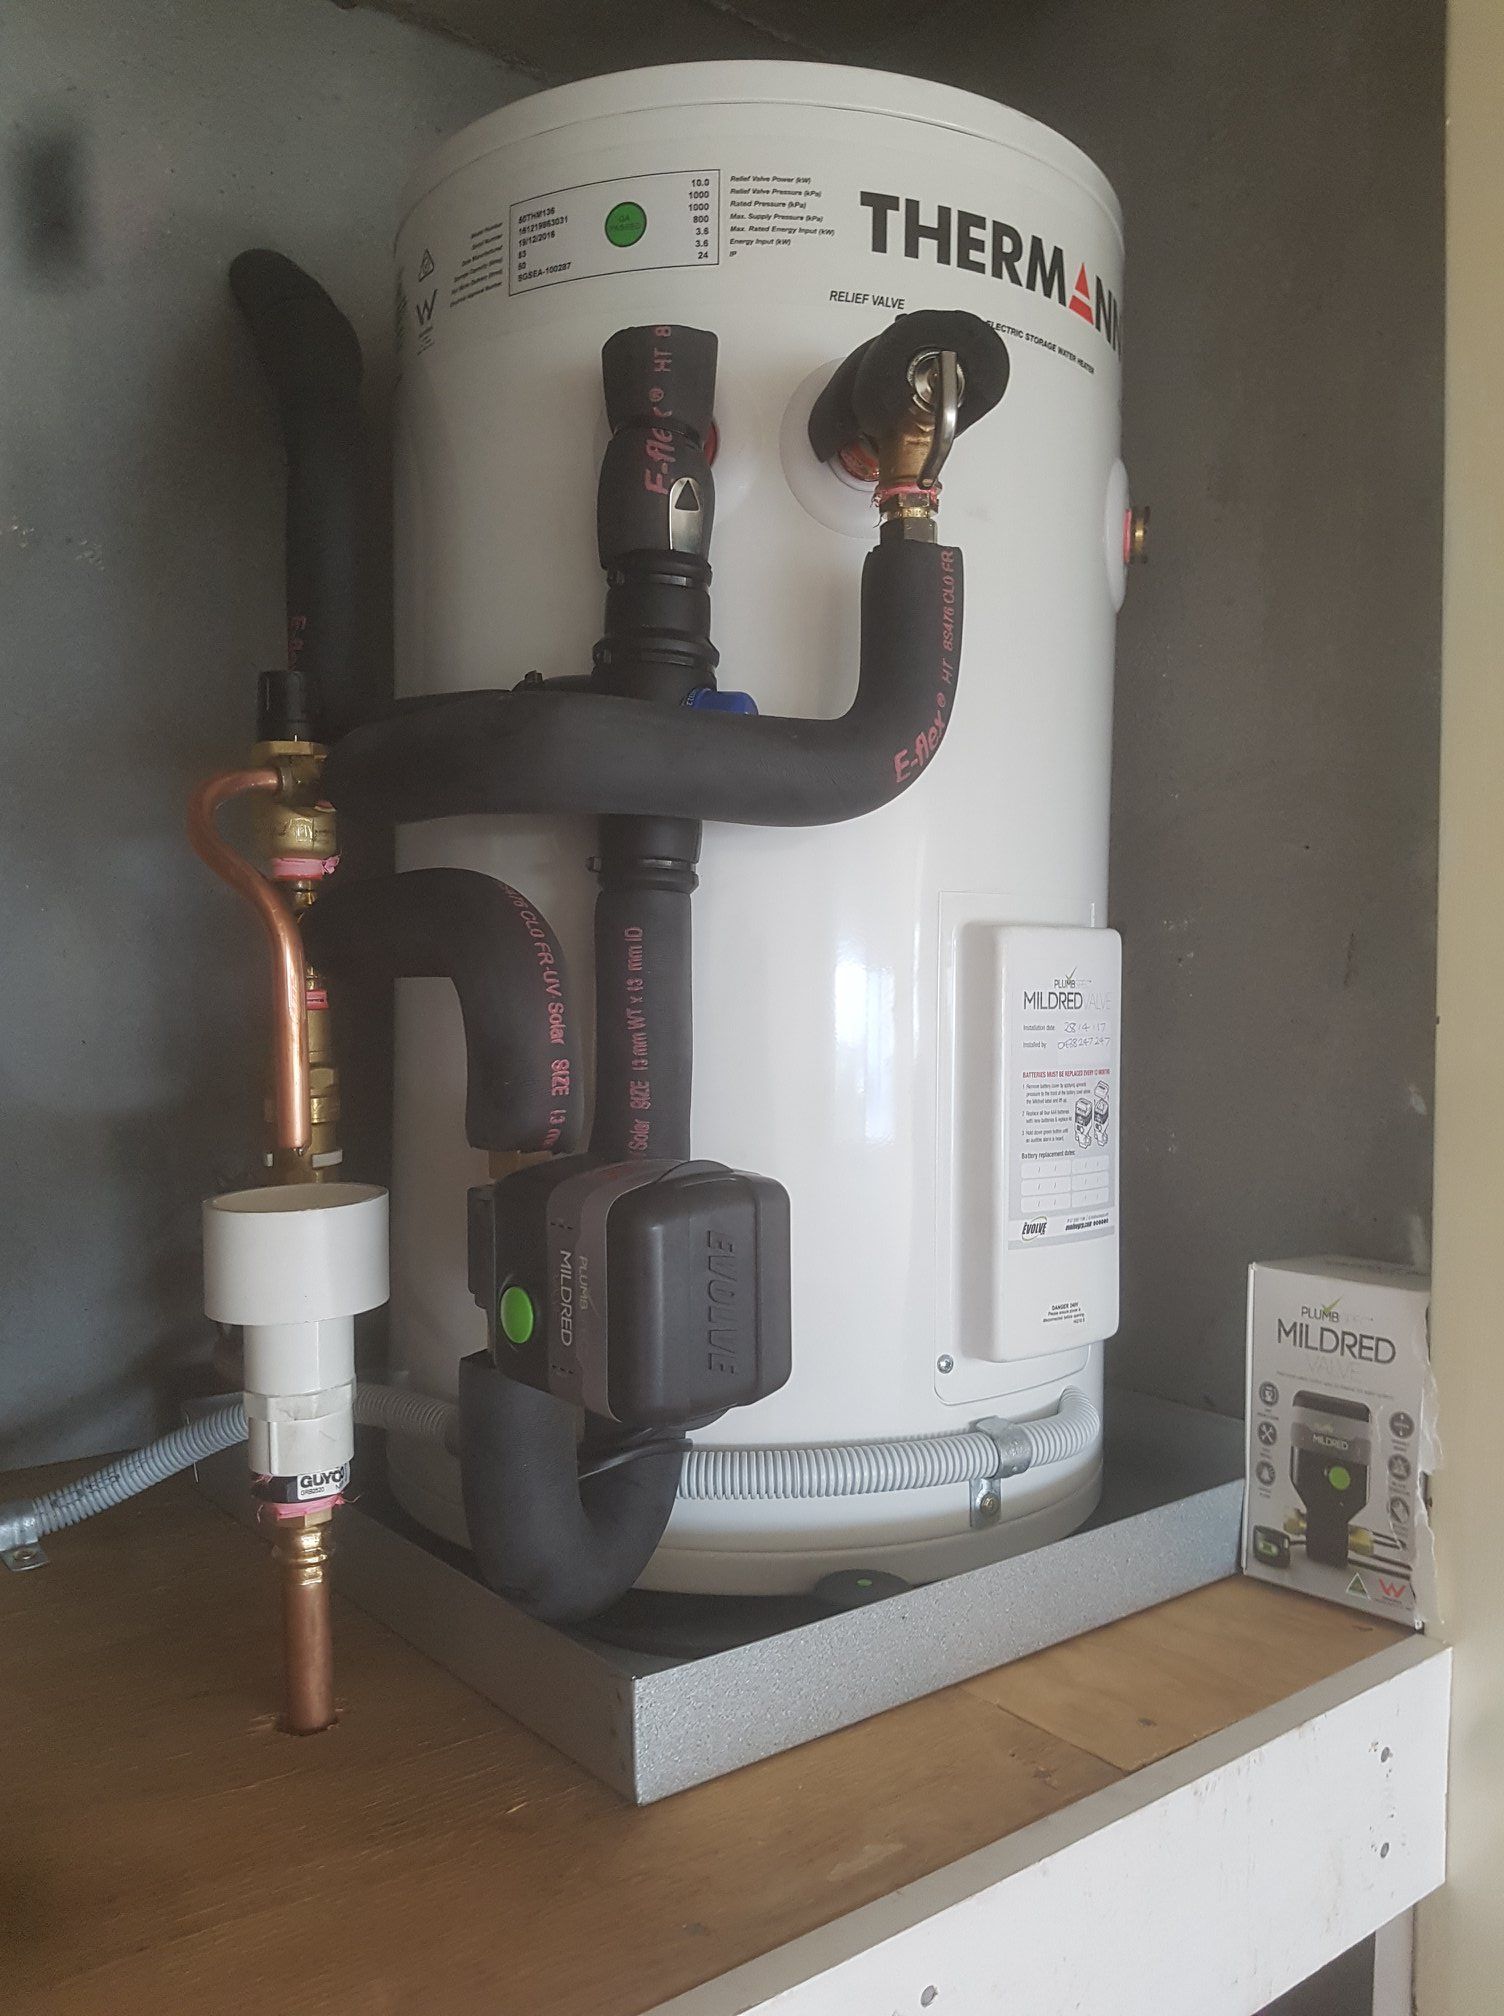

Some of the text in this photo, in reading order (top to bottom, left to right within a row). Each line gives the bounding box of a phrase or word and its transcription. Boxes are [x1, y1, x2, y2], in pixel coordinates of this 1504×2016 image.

[691, 178, 710, 187] 10.0
[688, 190, 710, 199] 1000
[688, 202, 710, 211] 1000
[753, 200, 786, 208] Pressure
[693, 215, 709, 223] 800
[748, 213, 772, 221] Supply
[773, 213, 804, 221] Pressure
[771, 226, 797, 234] Energy
[798, 227, 817, 235] Input
[729, 238, 754, 246] Energy
[755, 238, 774, 246] Input
[698, 251, 708, 260] 24
[829, 290, 905, 310] RELIEF VALVE
[654, 347, 672, 372] HT
[1025, 332, 1057, 352] STORAGE
[1057, 346, 1077, 361] WATER
[1077, 358, 1095, 374] HEATER
[941, 657, 954, 684] HT
[627, 945, 643, 971] mm
[1053, 978, 1076, 989] PLUMB
[1023, 991, 1083, 1010] MILDRED
[547, 1002, 566, 1044] Solar
[551, 1059, 570, 1096] SIZE
[1022, 1071, 1047, 1079] BATTERIES
[629, 1080, 651, 1110] SIZE
[628, 1118, 650, 1151] Solar
[1021, 1152, 1038, 1160] Battery
[1038, 1151, 1064, 1159] replacement
[1021, 1221, 1047, 1236] EVOLVE
[560, 1249, 573, 1347] MILDRED
[1301, 1305, 1340, 1323] PLUMB
[1277, 1318, 1397, 1365] MILDRED
[1312, 1433, 1349, 1450] MILDRED
